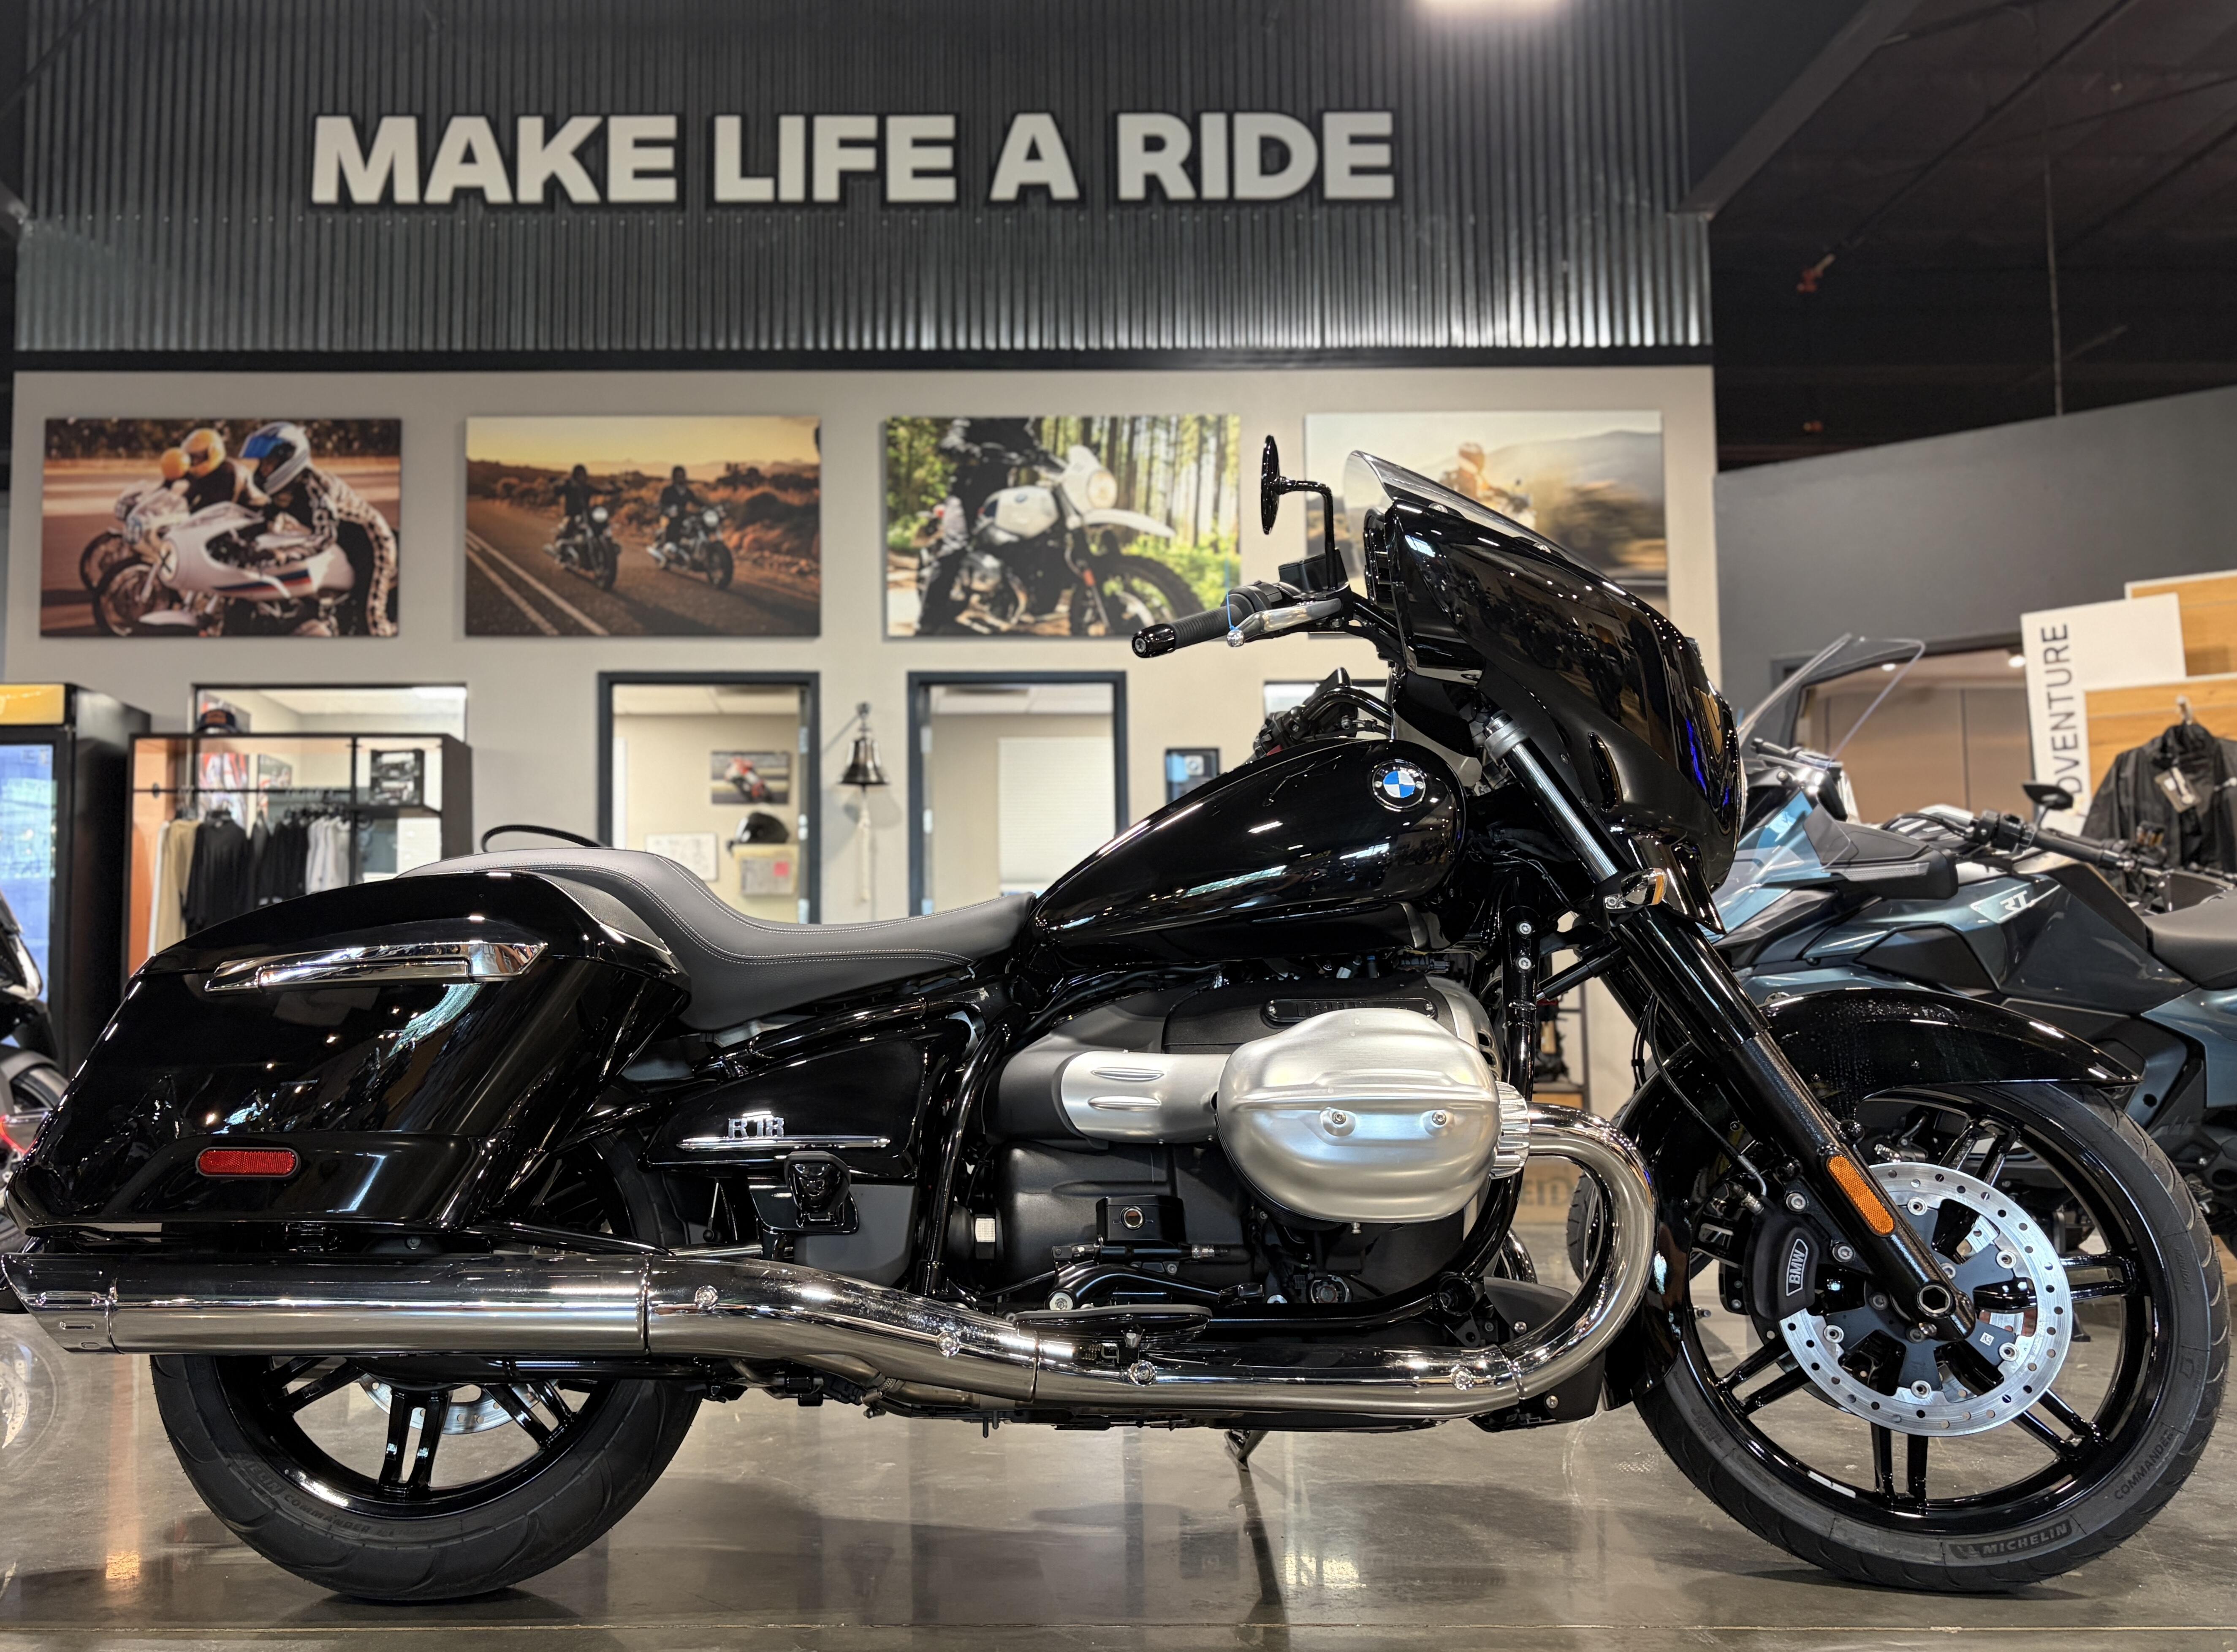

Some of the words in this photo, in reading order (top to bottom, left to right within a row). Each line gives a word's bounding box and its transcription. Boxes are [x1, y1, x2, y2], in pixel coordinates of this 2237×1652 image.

[312, 116, 676, 203] MAKE
[714, 115, 956, 201] LIFE
[991, 114, 1078, 200] A
[1118, 112, 1394, 199] RIDE
[2041, 623, 2082, 795] DVENTURE
[1789, 1249, 1805, 1284] BMW
[2114, 1429, 2174, 1499] COMMANDER
[1982, 1523, 2068, 1555] MICHELIN
